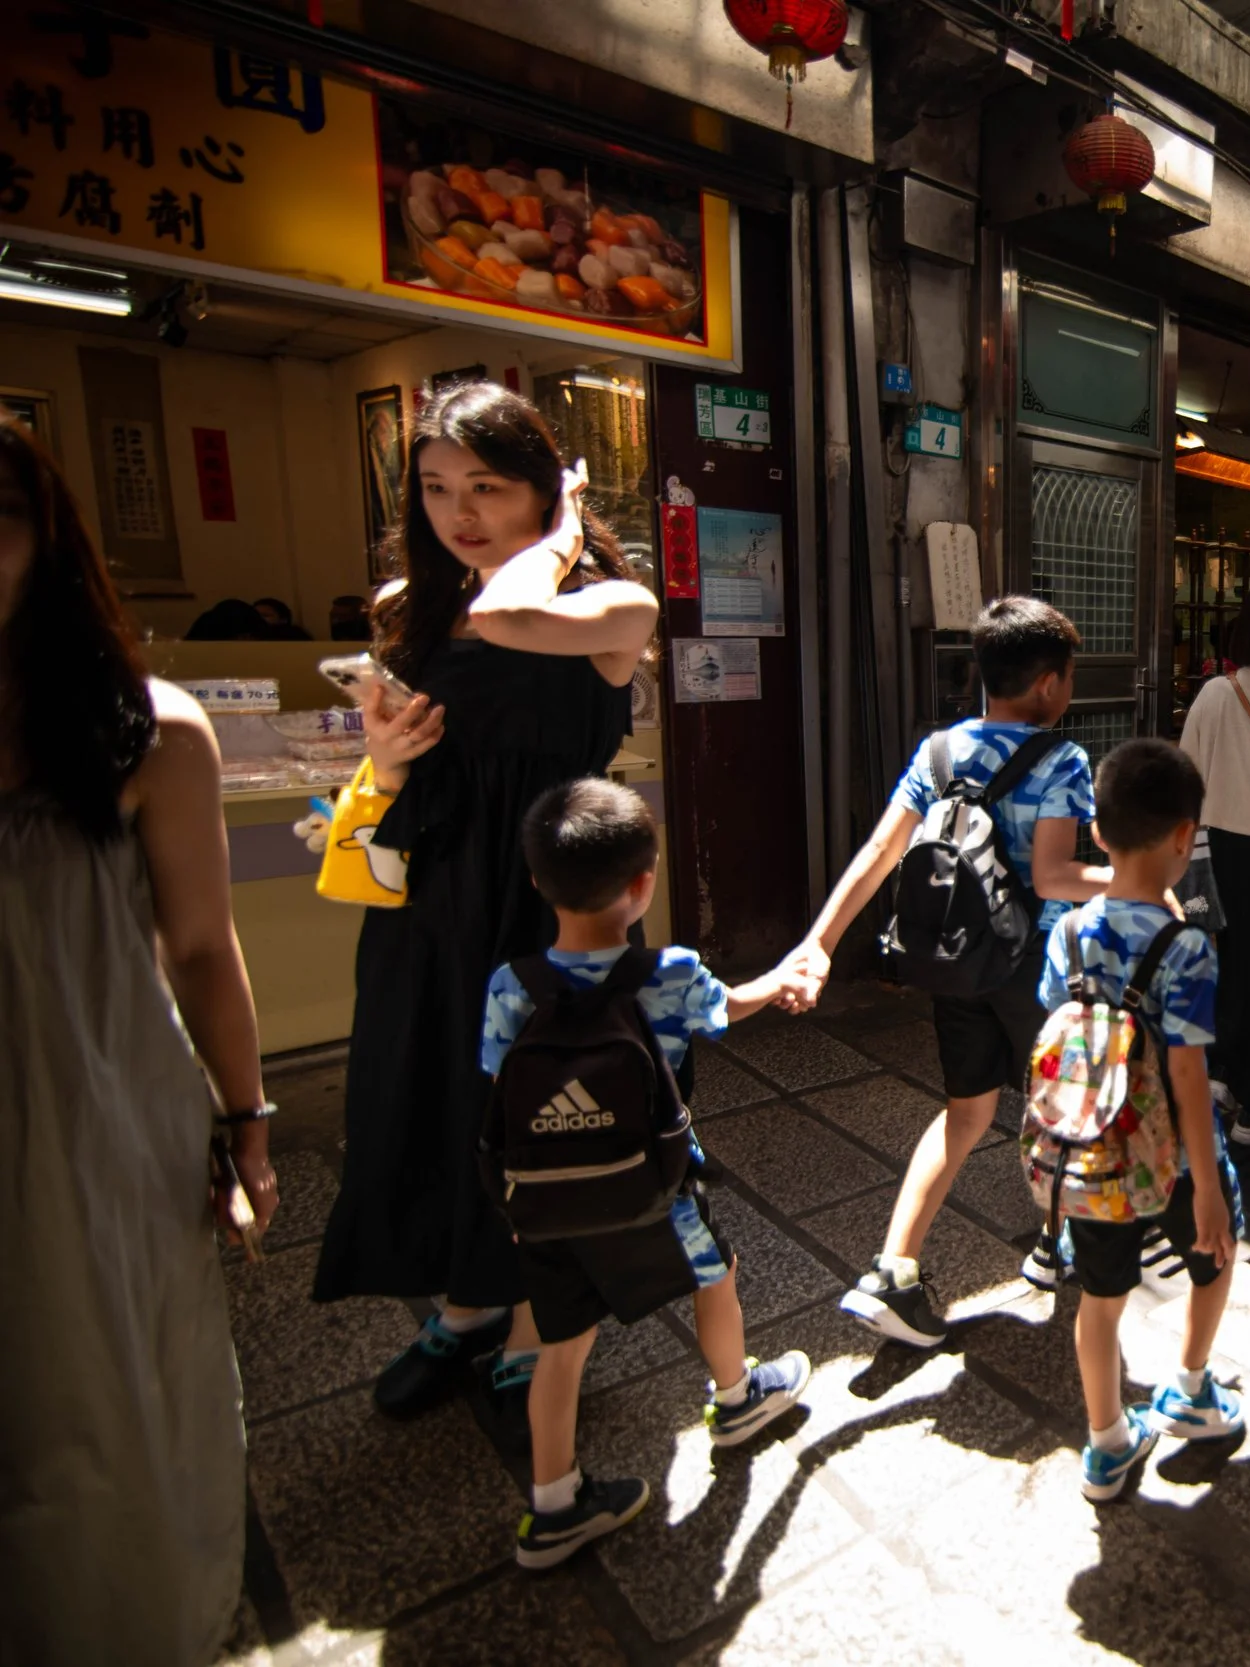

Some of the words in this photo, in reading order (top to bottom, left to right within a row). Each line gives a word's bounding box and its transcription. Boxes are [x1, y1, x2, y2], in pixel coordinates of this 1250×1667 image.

[712, 387, 769, 410] 基山街
[735, 412, 751, 437] 4
[935, 427, 947, 450] 4
[530, 1109, 617, 1134] adidas
